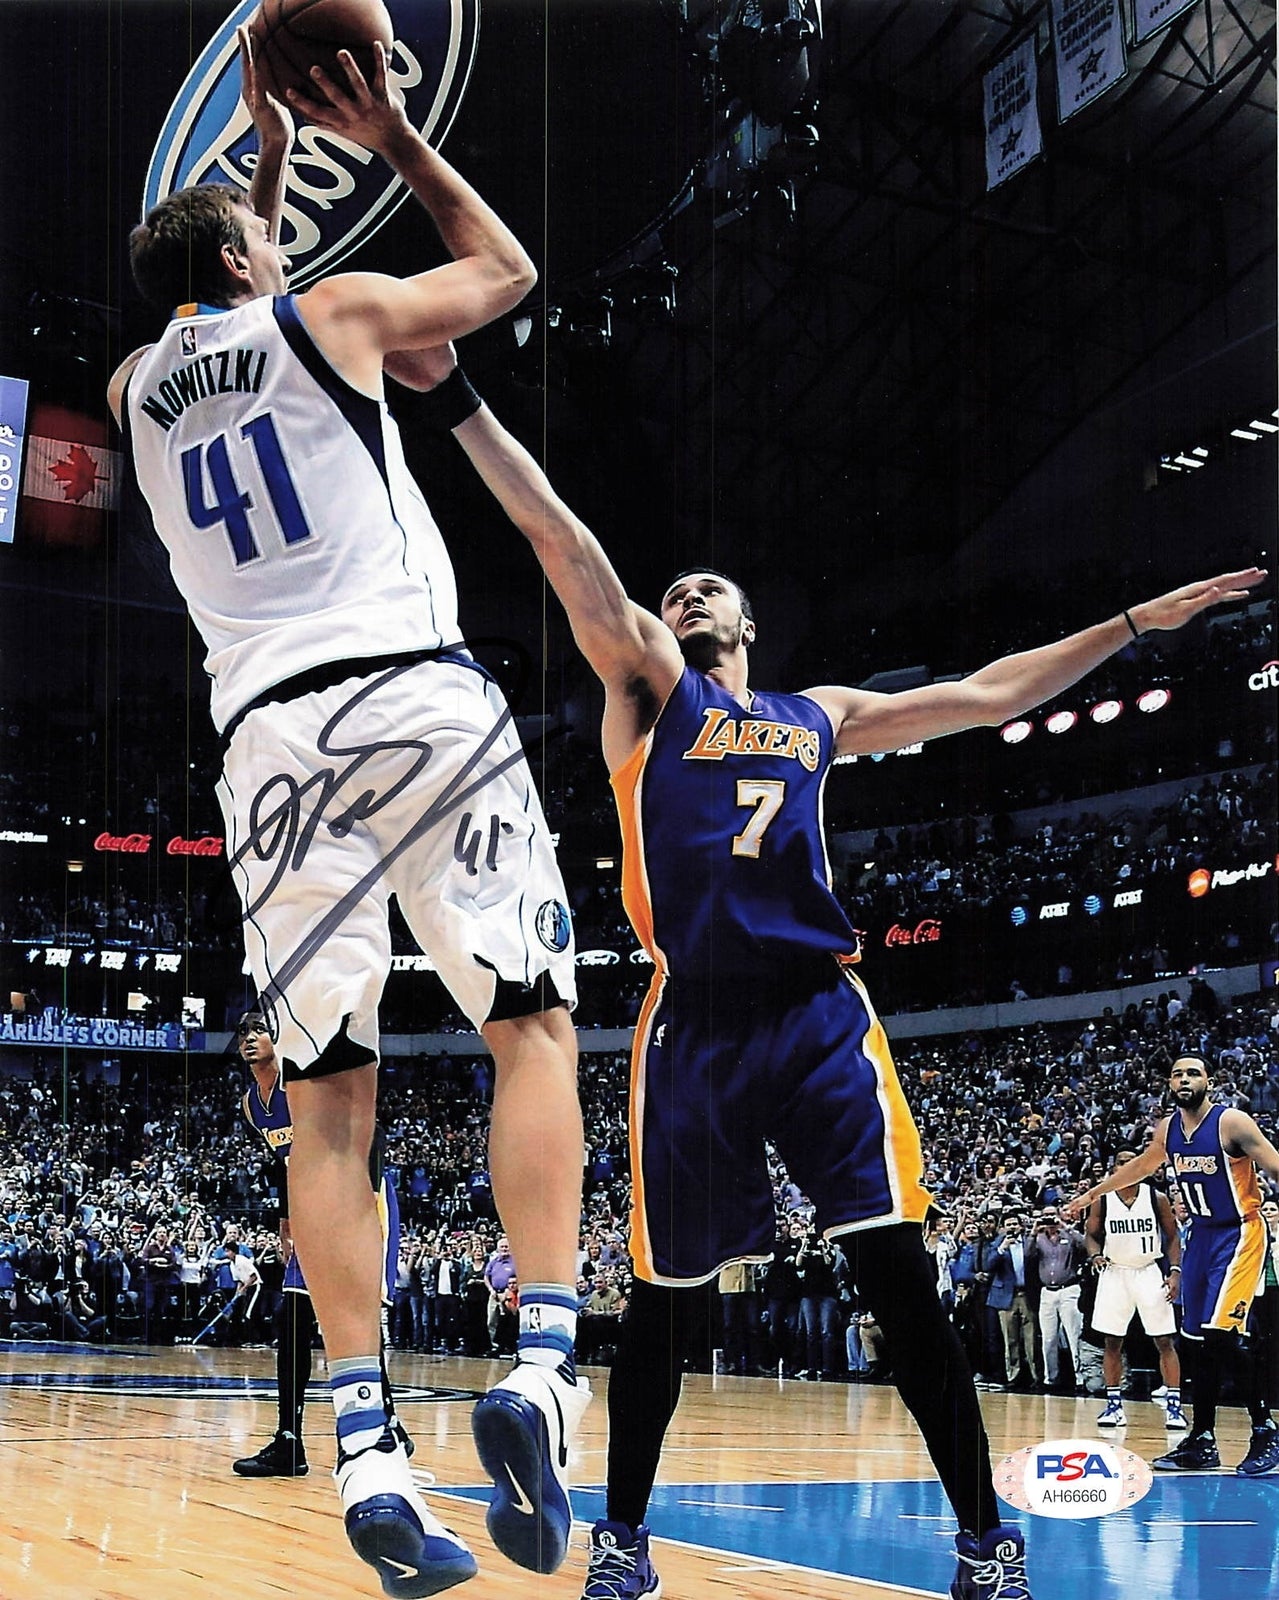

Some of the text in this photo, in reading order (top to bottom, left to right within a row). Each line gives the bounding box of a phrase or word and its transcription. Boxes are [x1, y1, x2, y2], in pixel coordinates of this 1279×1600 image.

[141, 349, 267, 432] NOWITZKI
[179, 408, 317, 572] 41
[682, 707, 820, 772] LAKERS
[732, 779, 785, 859] 7
[0, 1022, 168, 1048] ARLISLE'S CORNER
[1181, 1182, 1212, 1217] 11
[1109, 1217, 1154, 1234] DALLAS
[1141, 1236, 1154, 1254] 11
